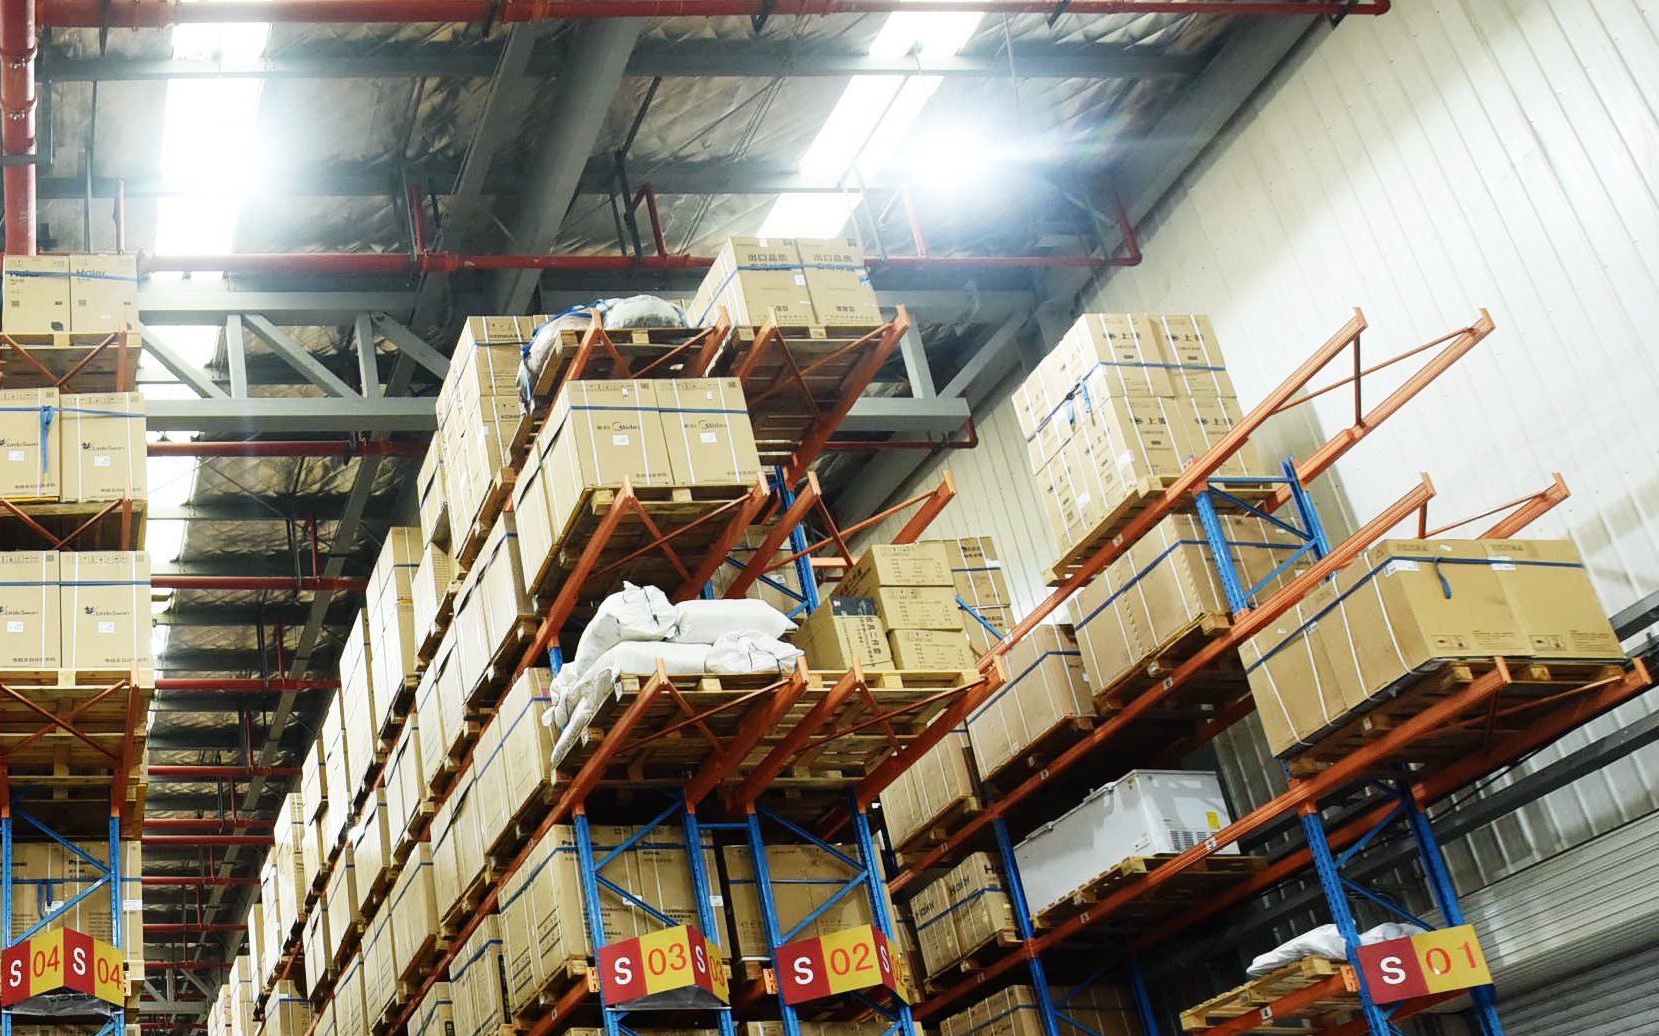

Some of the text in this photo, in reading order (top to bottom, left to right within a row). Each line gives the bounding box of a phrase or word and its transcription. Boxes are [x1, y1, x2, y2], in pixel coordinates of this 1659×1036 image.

[9, 945, 60, 987] S 04
[72, 947, 121, 990] S 04
[614, 943, 687, 985] S 03
[695, 945, 725, 988] S 03
[793, 942, 873, 985] S 02
[880, 944, 891, 973] S
[1380, 941, 1476, 984] S 01
